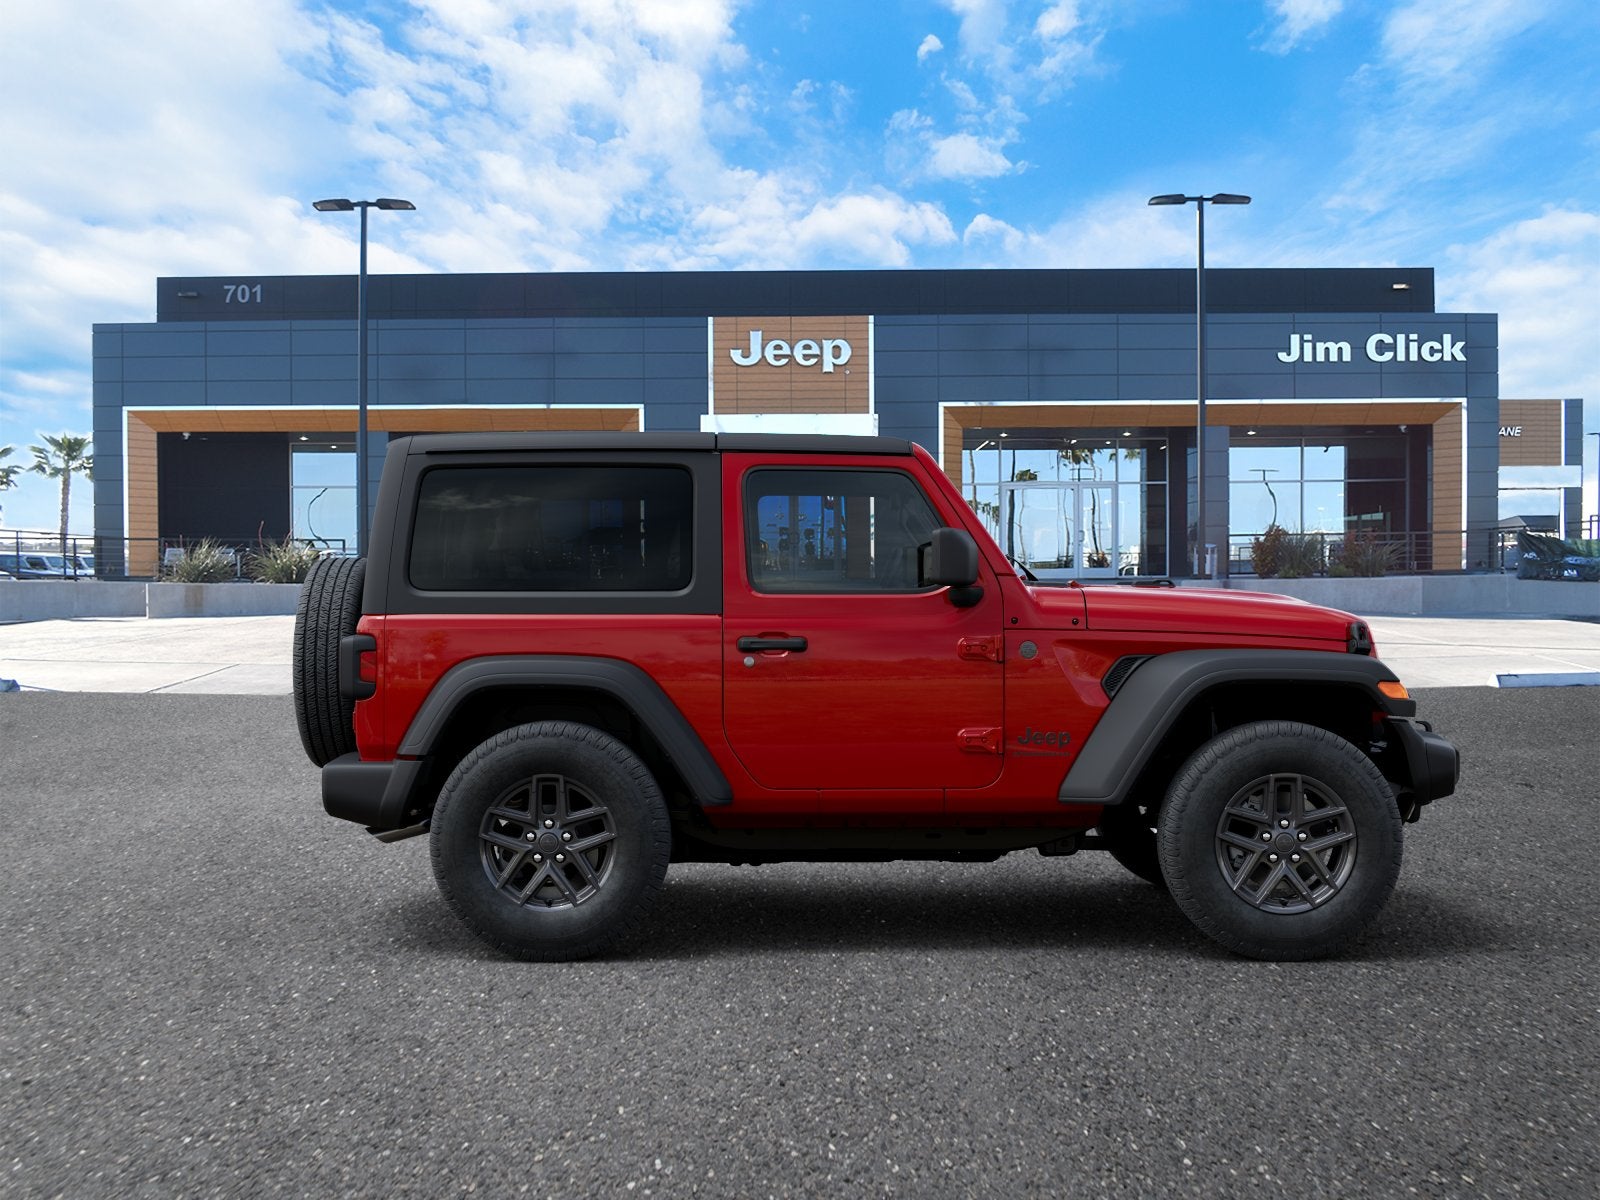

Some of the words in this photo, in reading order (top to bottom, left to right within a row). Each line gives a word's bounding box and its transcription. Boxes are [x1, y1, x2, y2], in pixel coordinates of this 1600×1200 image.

[223, 284, 262, 303] 701
[729, 330, 852, 373] Jeep
[1277, 333, 1352, 362] Jim
[1366, 332, 1467, 363] Click
[1017, 726, 1072, 749] Jeep
